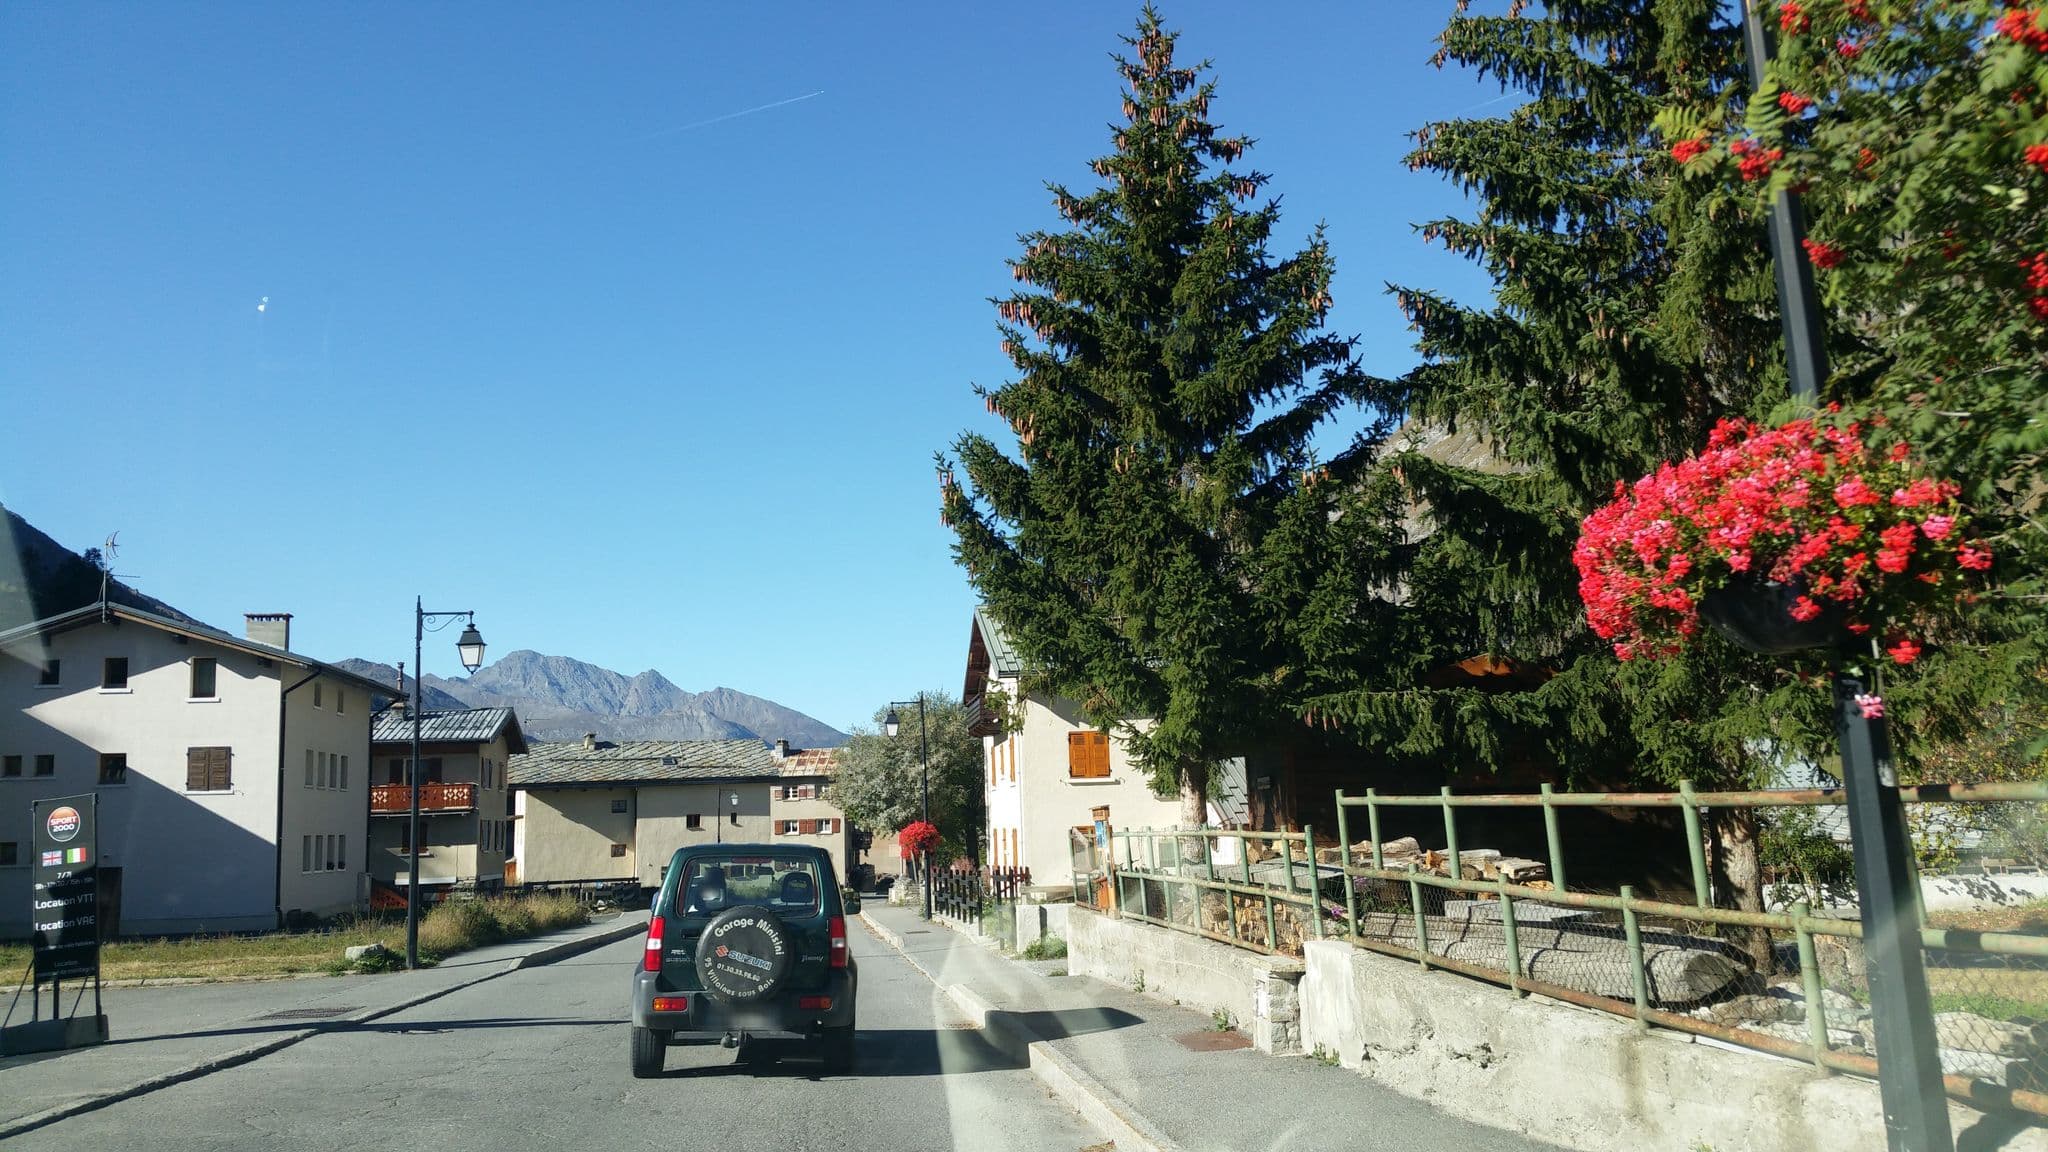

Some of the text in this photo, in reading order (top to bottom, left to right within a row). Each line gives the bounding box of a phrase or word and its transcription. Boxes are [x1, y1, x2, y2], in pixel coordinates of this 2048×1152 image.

[50, 816, 77, 826] SPORT
[53, 824, 75, 832] 2000
[35, 893, 94, 909] Location VTT
[35, 919, 76, 931] Location
[714, 918, 784, 955] Garage Minisini
[728, 950, 773, 971] SUZUKI
[738, 989, 756, 997] sous
[757, 978, 775, 992] Bois
